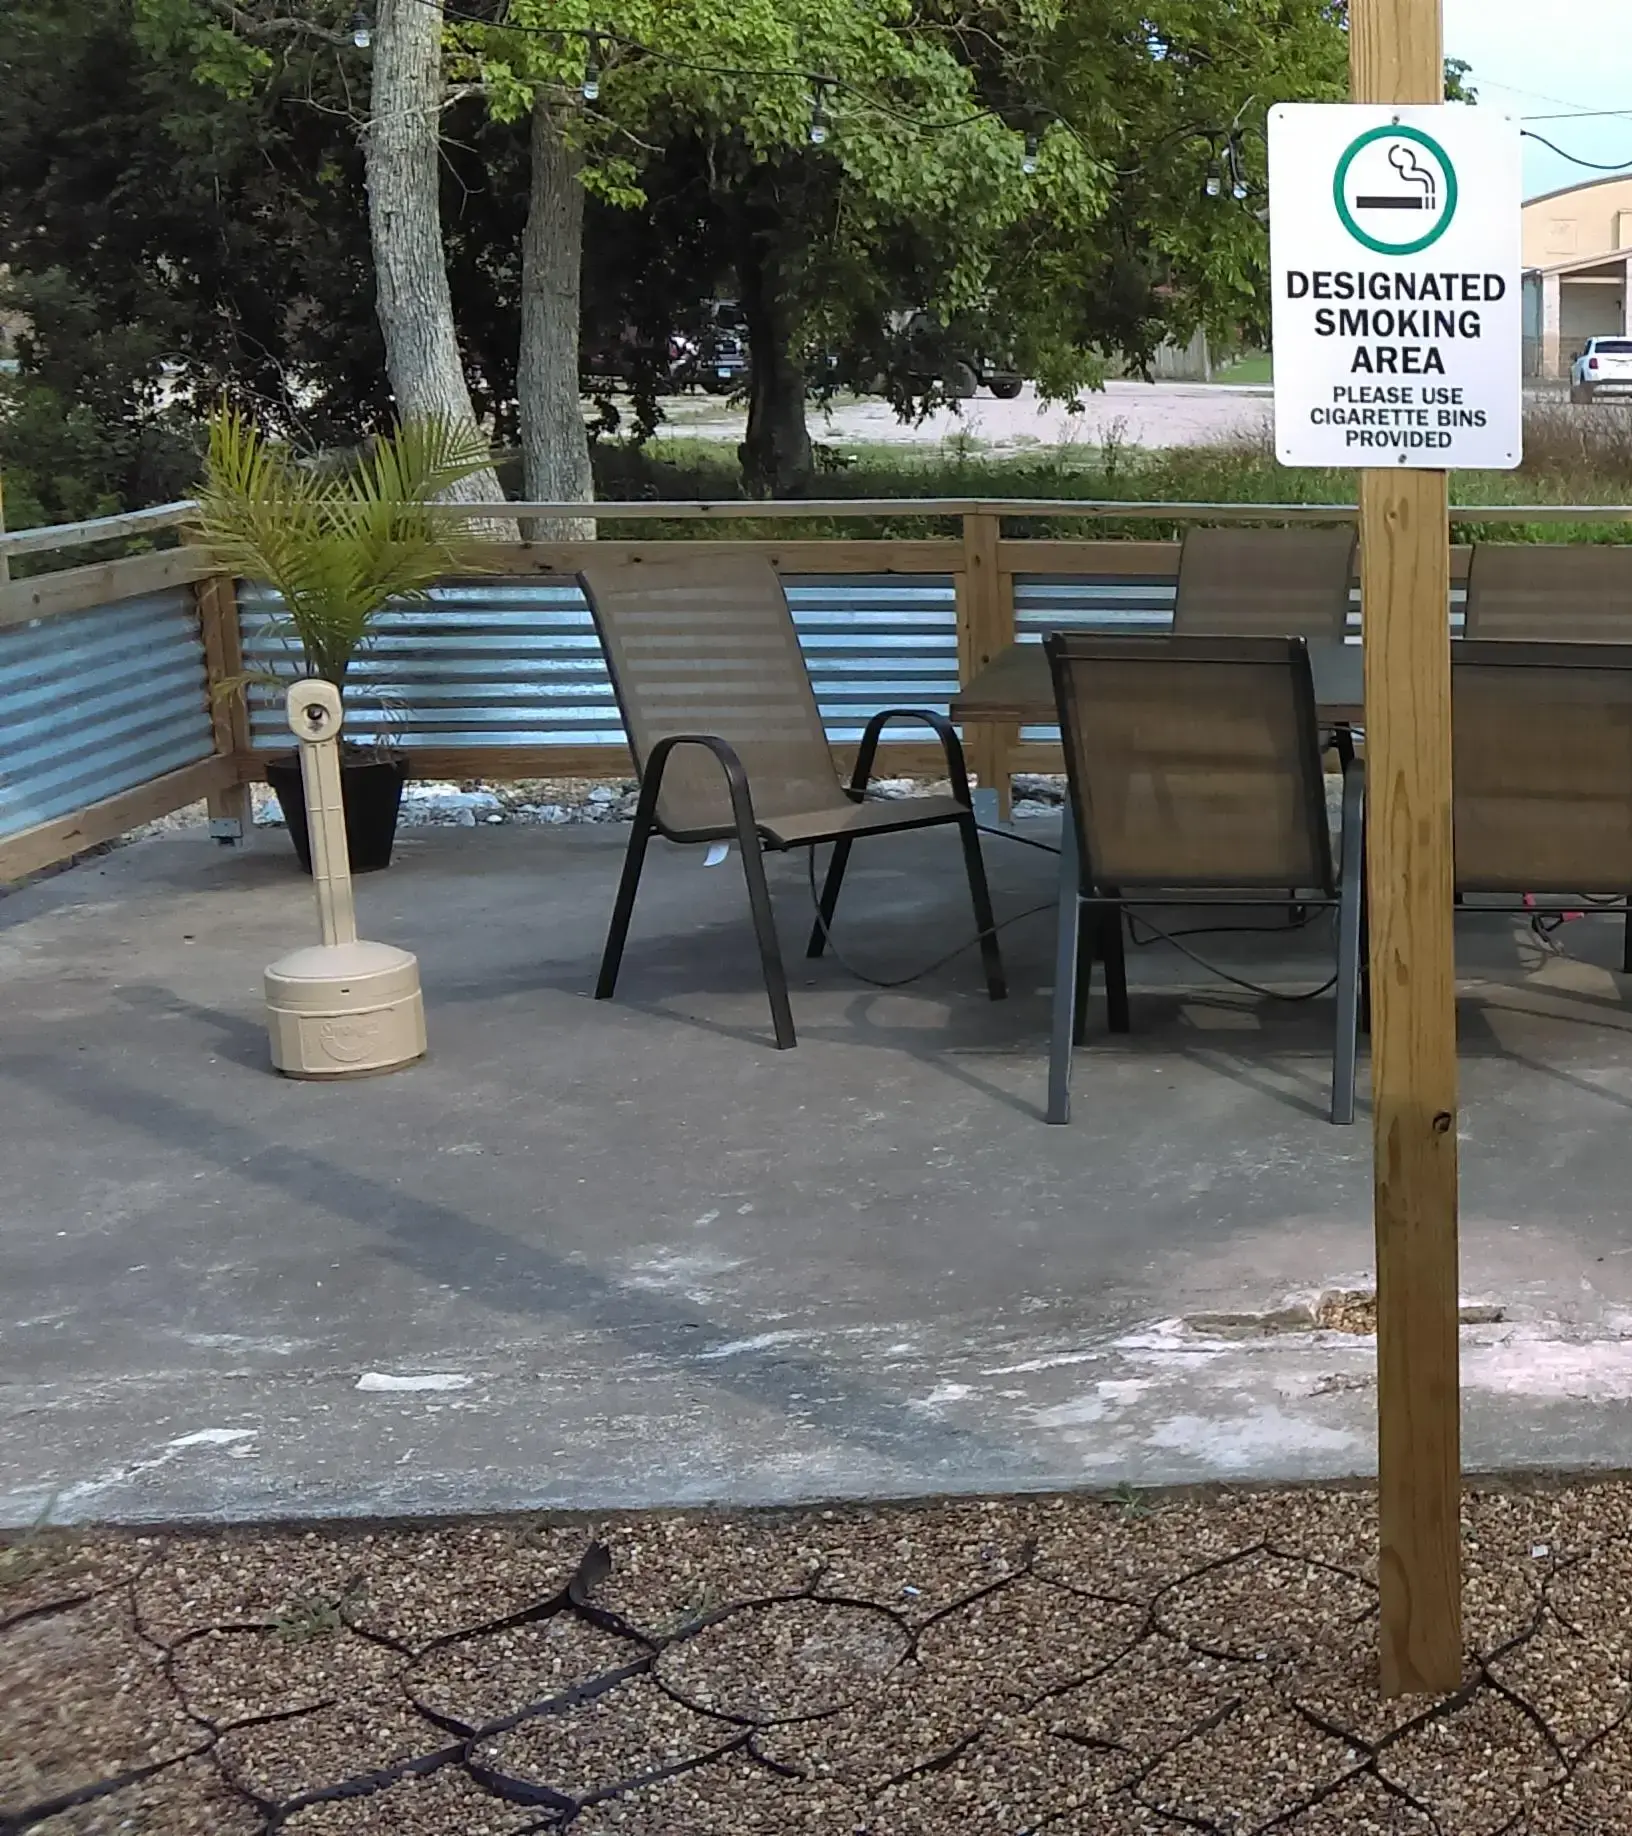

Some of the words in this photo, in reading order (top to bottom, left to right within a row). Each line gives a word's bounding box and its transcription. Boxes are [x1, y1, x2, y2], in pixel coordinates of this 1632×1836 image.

[1286, 271, 1506, 301] DESIGNATED
[1314, 308, 1481, 338] SMOKING
[1350, 345, 1446, 375] AREA
[1333, 386, 1413, 404] PLEASE
[1422, 387, 1463, 405] USE
[1310, 408, 1428, 427] CIGARETTE
[1437, 410, 1487, 427] BINS
[1345, 430, 1452, 448] PROVIDED
